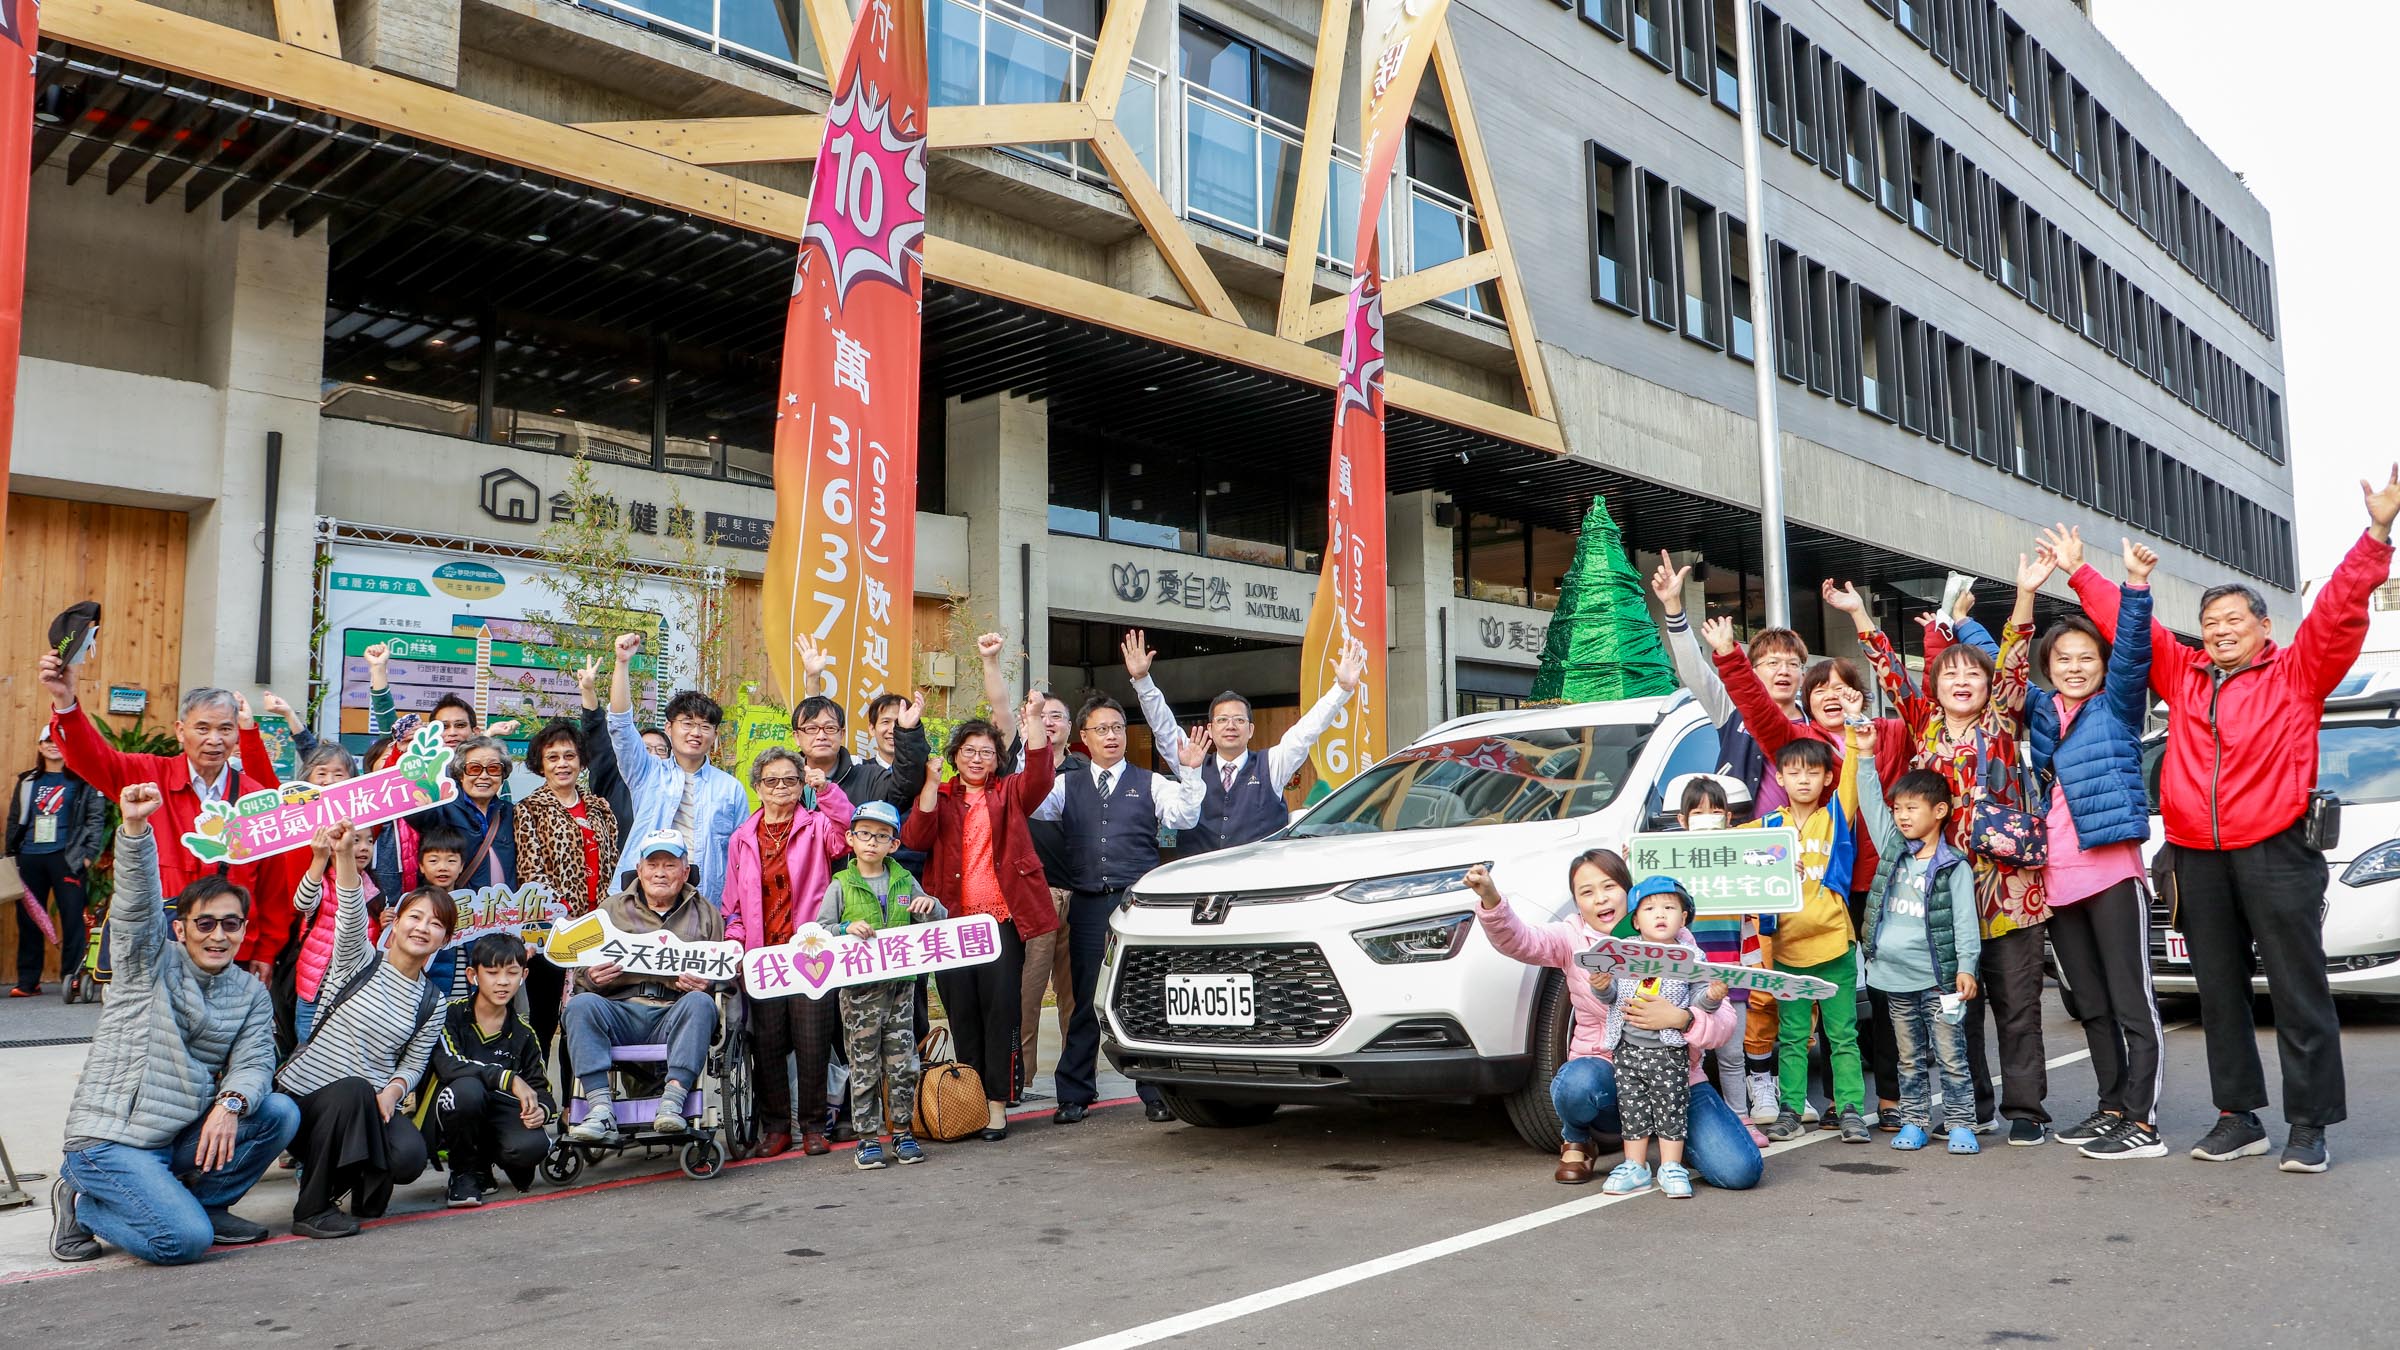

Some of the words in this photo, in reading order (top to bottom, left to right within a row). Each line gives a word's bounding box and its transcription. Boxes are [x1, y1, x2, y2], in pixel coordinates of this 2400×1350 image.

[830, 130, 883, 238] 10
[831, 326, 871, 406] 萬
[337, 576, 417, 593] 樓層分佈介紹
[1156, 570, 1232, 611] 愛自然
[1245, 582, 1278, 601] LOVE
[1246, 602, 1304, 622] NATURAL
[675, 644, 686, 653] 6F
[403, 758, 422, 772] 2020
[242, 794, 278, 813] 9453
[245, 777, 411, 848] 福氣小旅行
[1637, 846, 1737, 870] 格上租車
[1681, 874, 1761, 898] 共生宅
[600, 939, 735, 975] 今天我尚水
[752, 953, 792, 990] 我
[839, 921, 996, 978] 裕隆集團
[1597, 940, 1690, 962] easy
